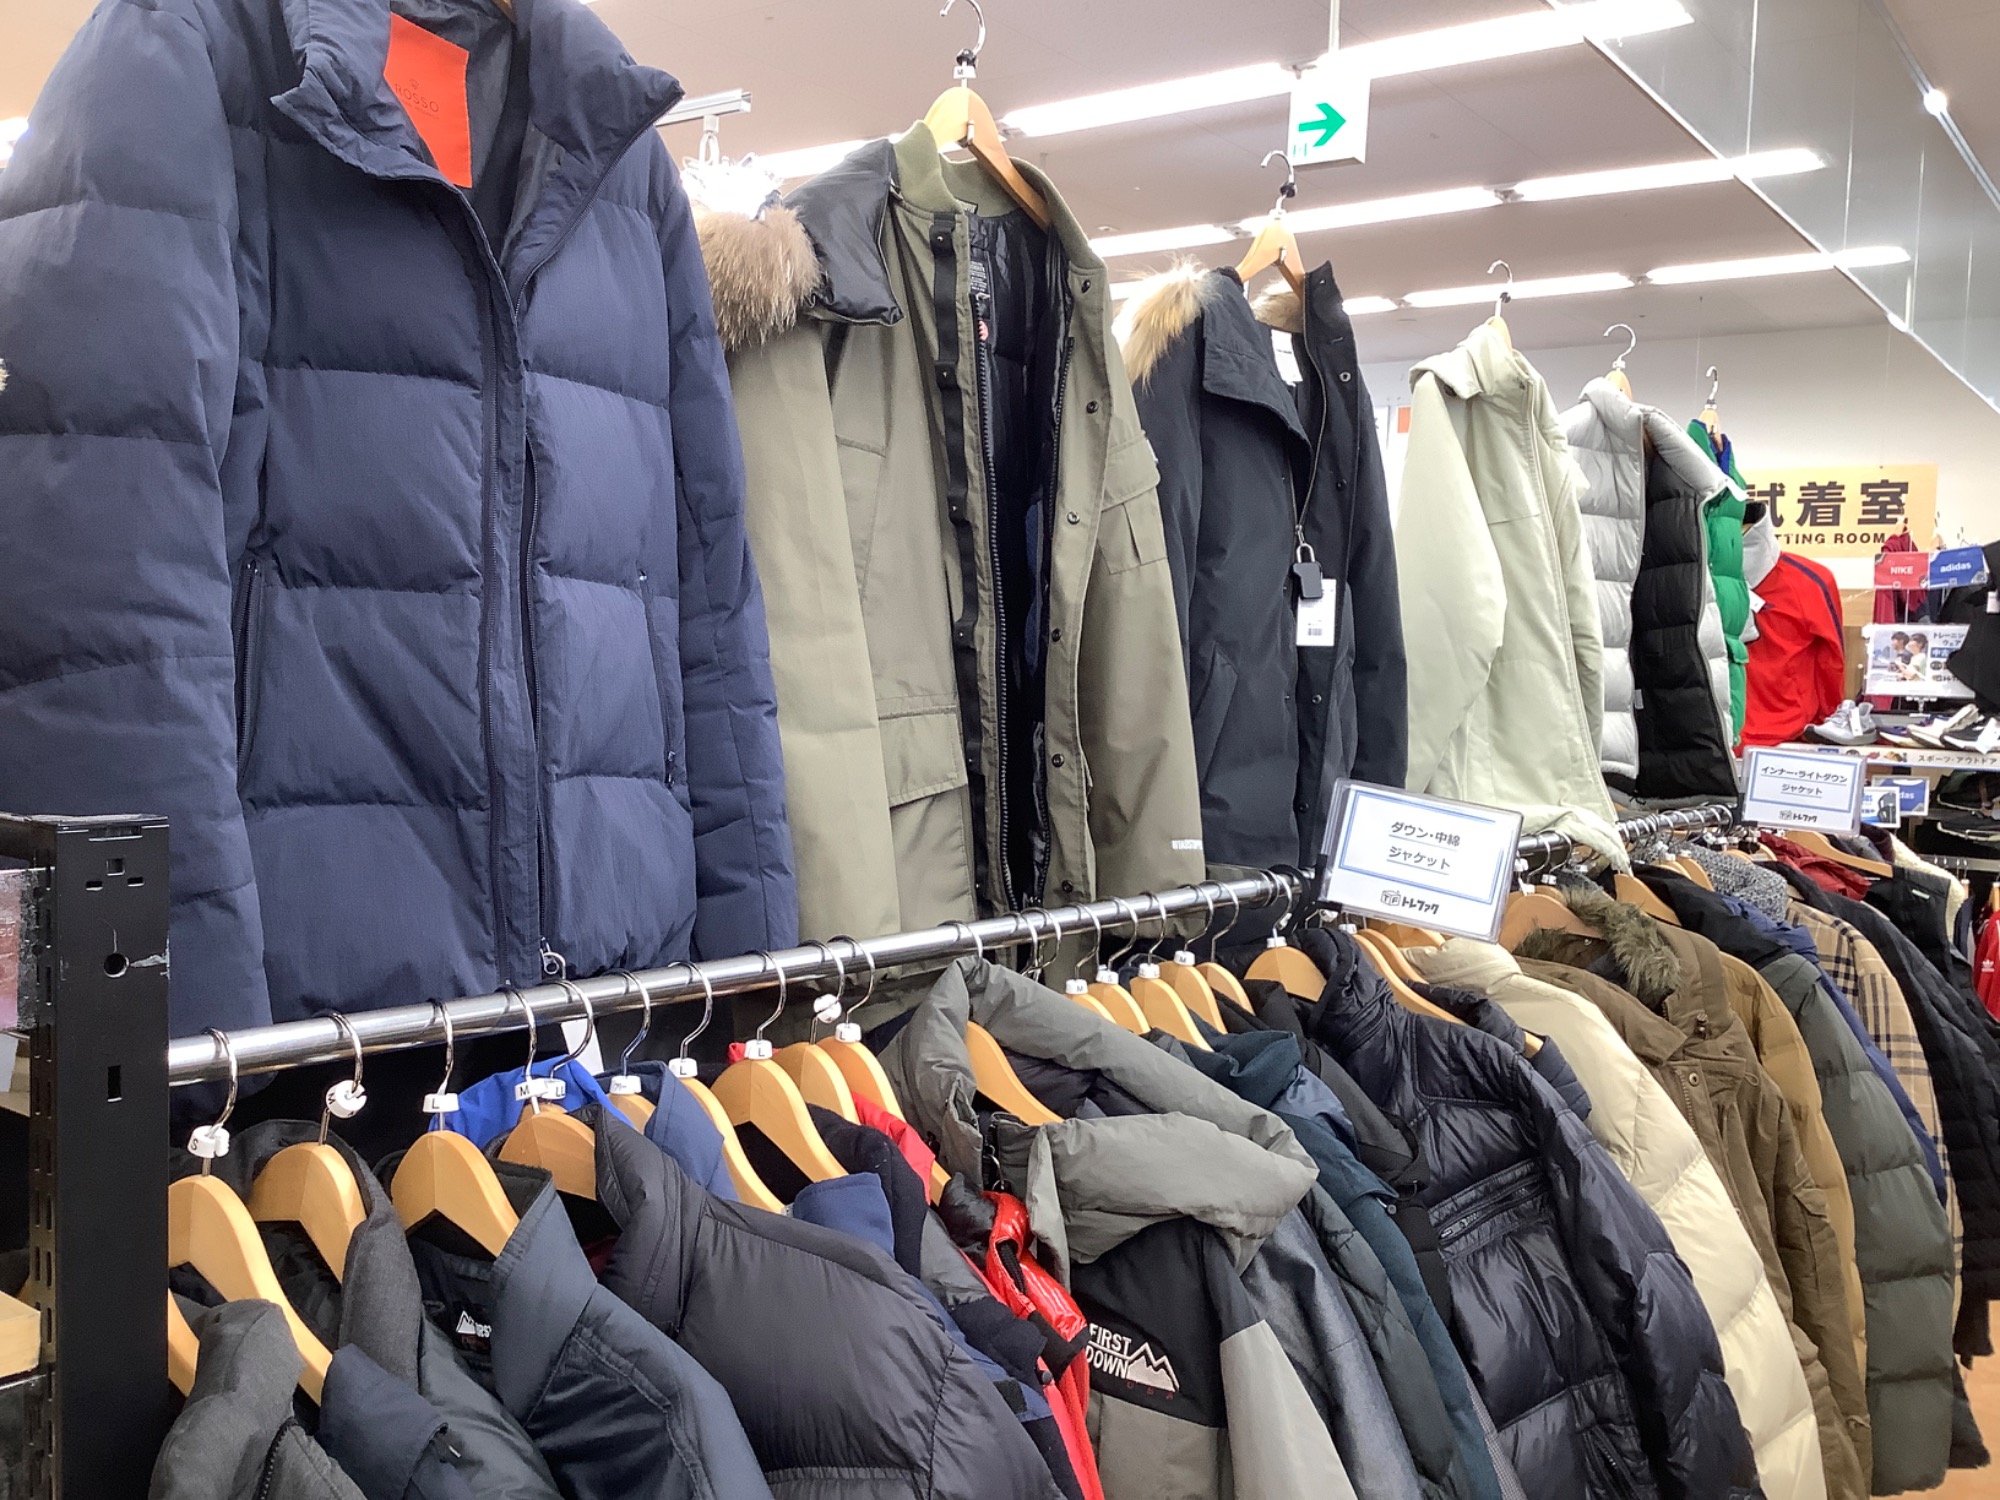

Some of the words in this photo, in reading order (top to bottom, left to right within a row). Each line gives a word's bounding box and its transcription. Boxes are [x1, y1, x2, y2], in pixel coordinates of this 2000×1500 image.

[394, 83, 440, 113] ROSSO
[1775, 533, 1825, 544] TTING
[1834, 532, 1885, 544] ROOM
[1890, 566, 1914, 575] NIKE
[1940, 562, 1972, 573] adidas
[1933, 631, 1965, 640] トレーニン
[1761, 766, 1848, 783] インナー・ライトダウン
[1781, 783, 1823, 795] ジャケット
[1391, 821, 1461, 847] ダウン・中綿
[1388, 846, 1450, 870] ジャケット
[758, 1047, 765, 1057] L
[680, 1066, 687, 1075] L
[520, 1085, 529, 1097] M
[556, 1086, 566, 1097] LL
[431, 1098, 440, 1109] L
[190, 1138, 199, 1151] S
[1089, 1322, 1132, 1356] FIRST
[1086, 1345, 1130, 1380] DOWN
